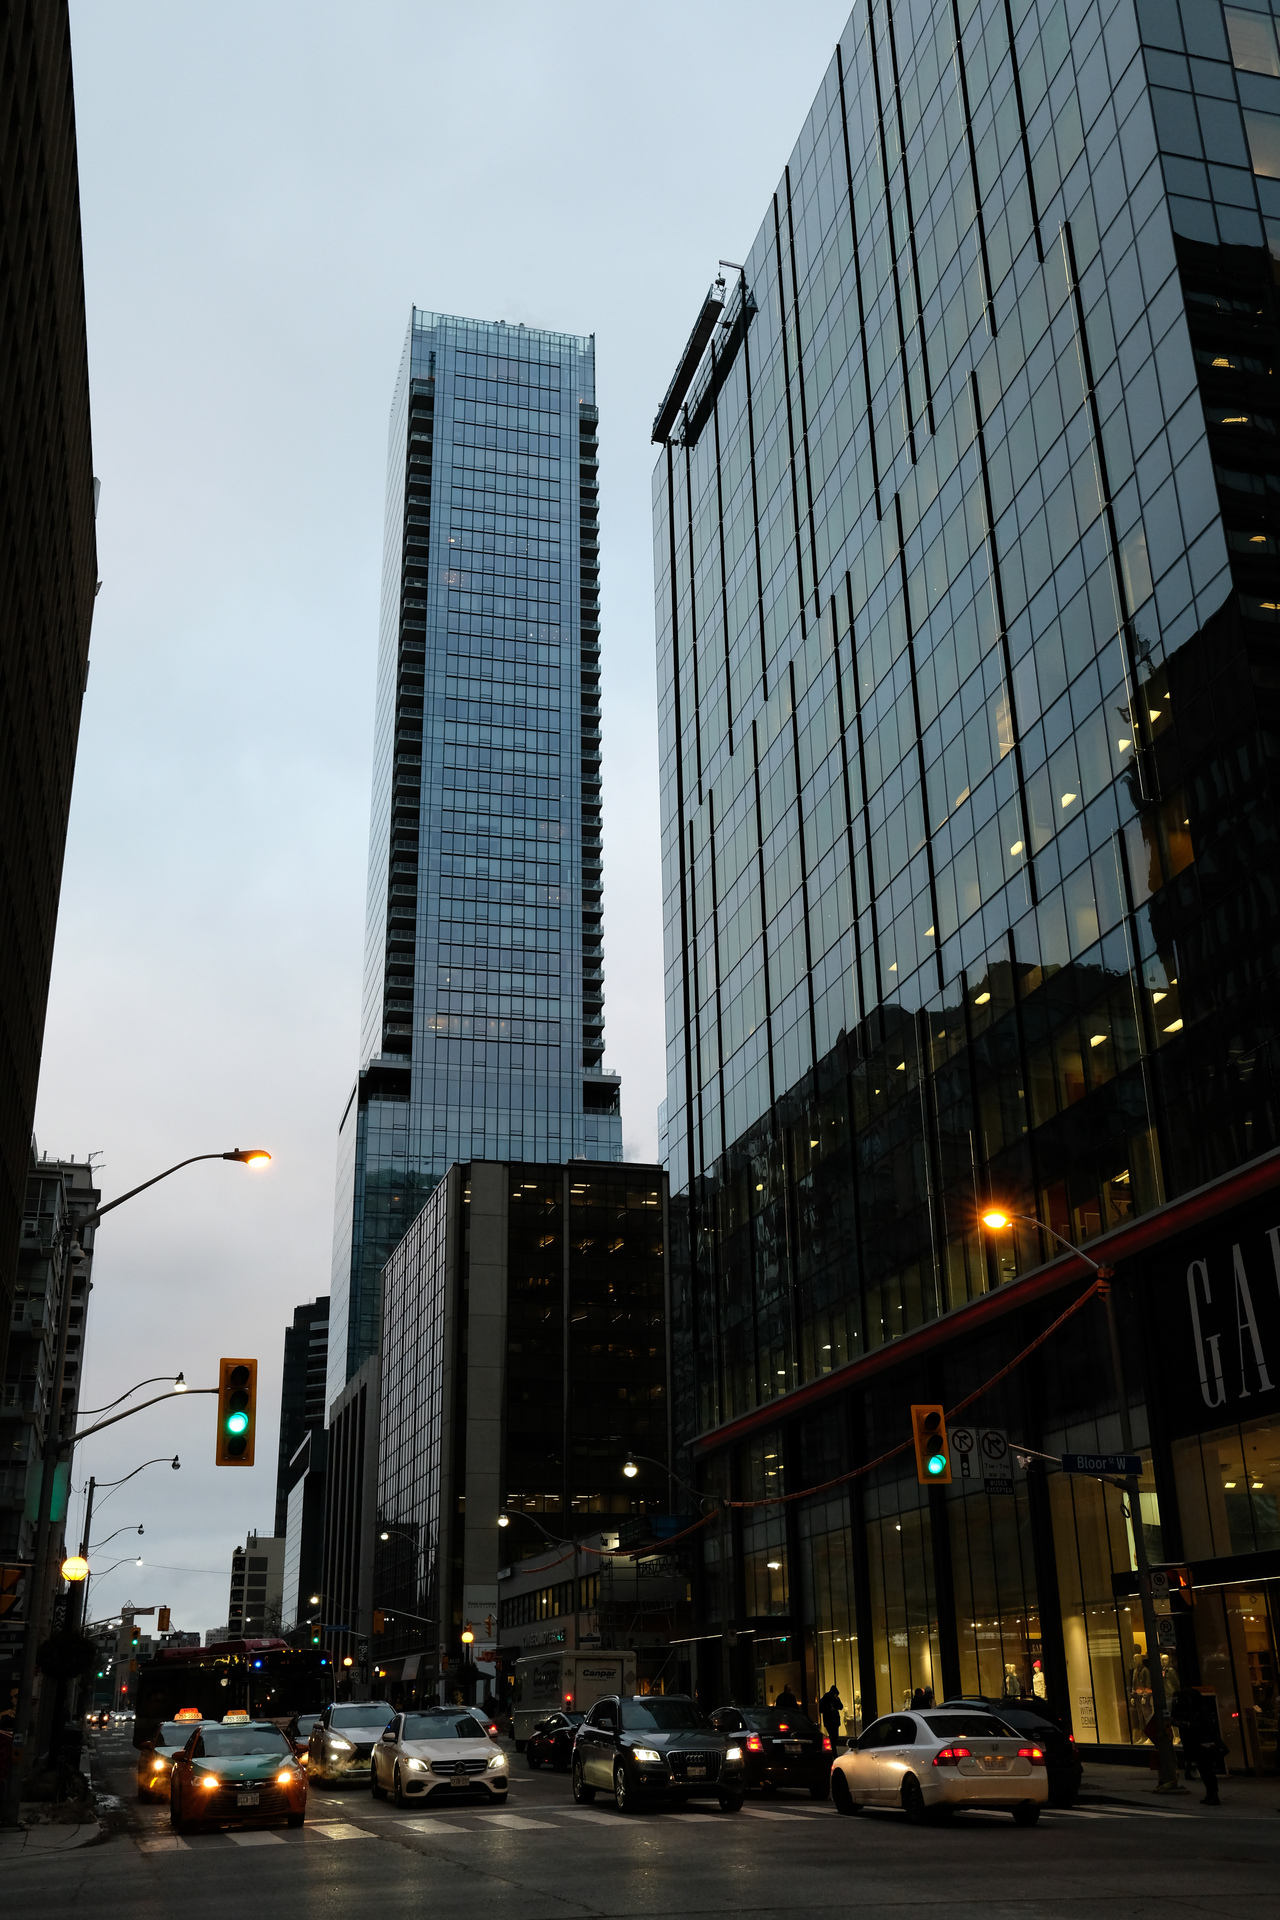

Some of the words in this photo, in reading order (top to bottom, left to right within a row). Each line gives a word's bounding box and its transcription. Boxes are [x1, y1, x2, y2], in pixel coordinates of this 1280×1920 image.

[1187, 1225, 1280, 1409] GA
[1077, 1456, 1107, 1469] Bloor
[1116, 1457, 1126, 1470] W
[10, 1633, 17, 1641] W
[583, 1669, 617, 1677] Canpar
[1080, 1707, 1092, 1715] WITH
